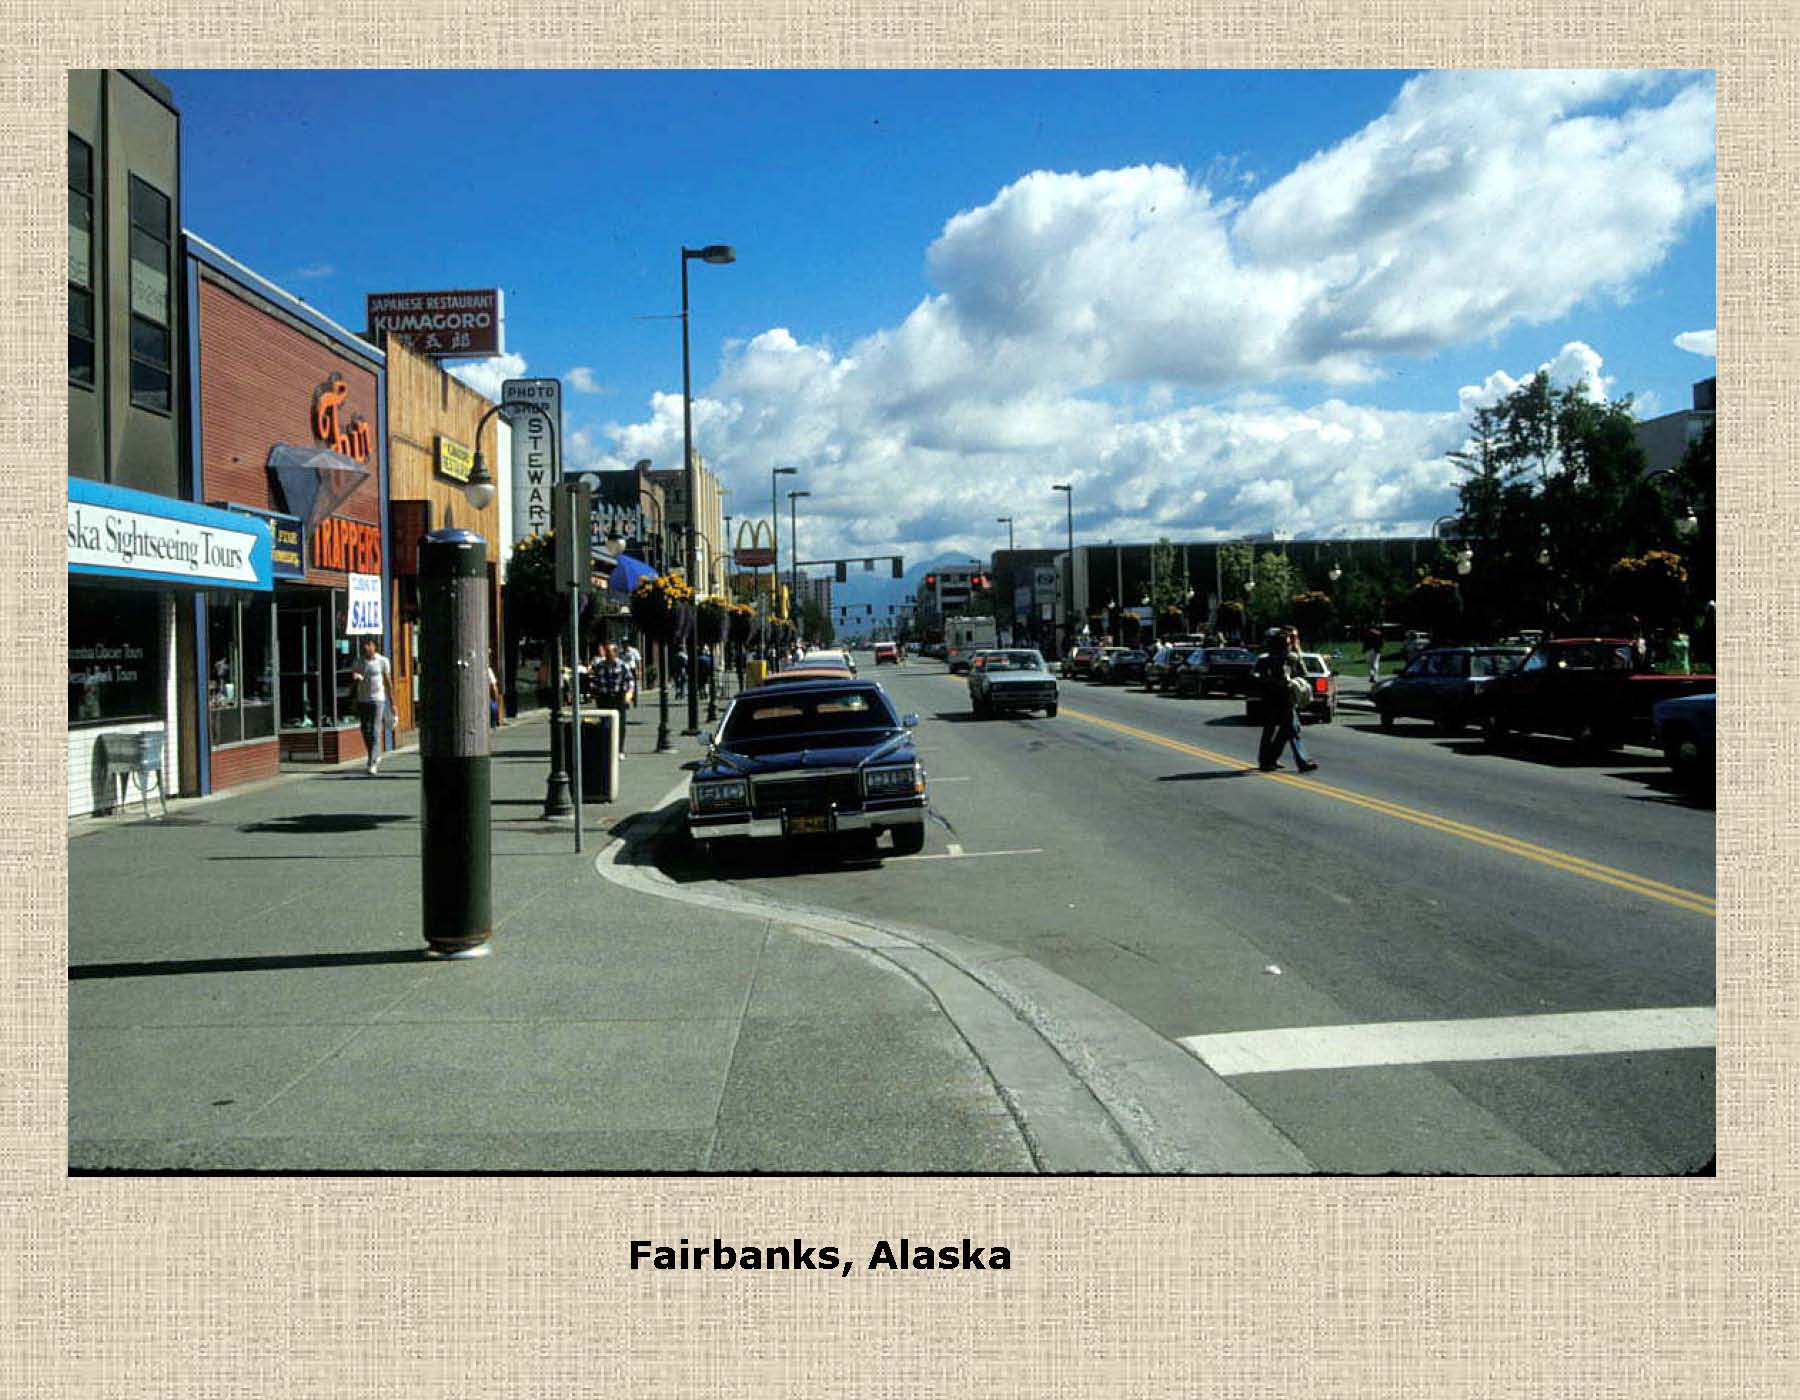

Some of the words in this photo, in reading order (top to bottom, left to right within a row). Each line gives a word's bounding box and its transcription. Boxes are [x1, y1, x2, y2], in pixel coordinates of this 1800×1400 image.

[372, 298, 422, 311] JAPANESE
[426, 295, 494, 309] RESTAURANT
[375, 313, 491, 331] KUMAGORO
[508, 386, 554, 398] PHOTO
[105, 515, 199, 571] Sightseeing
[201, 531, 243, 569] Tours
[352, 600, 379, 629] SALE
